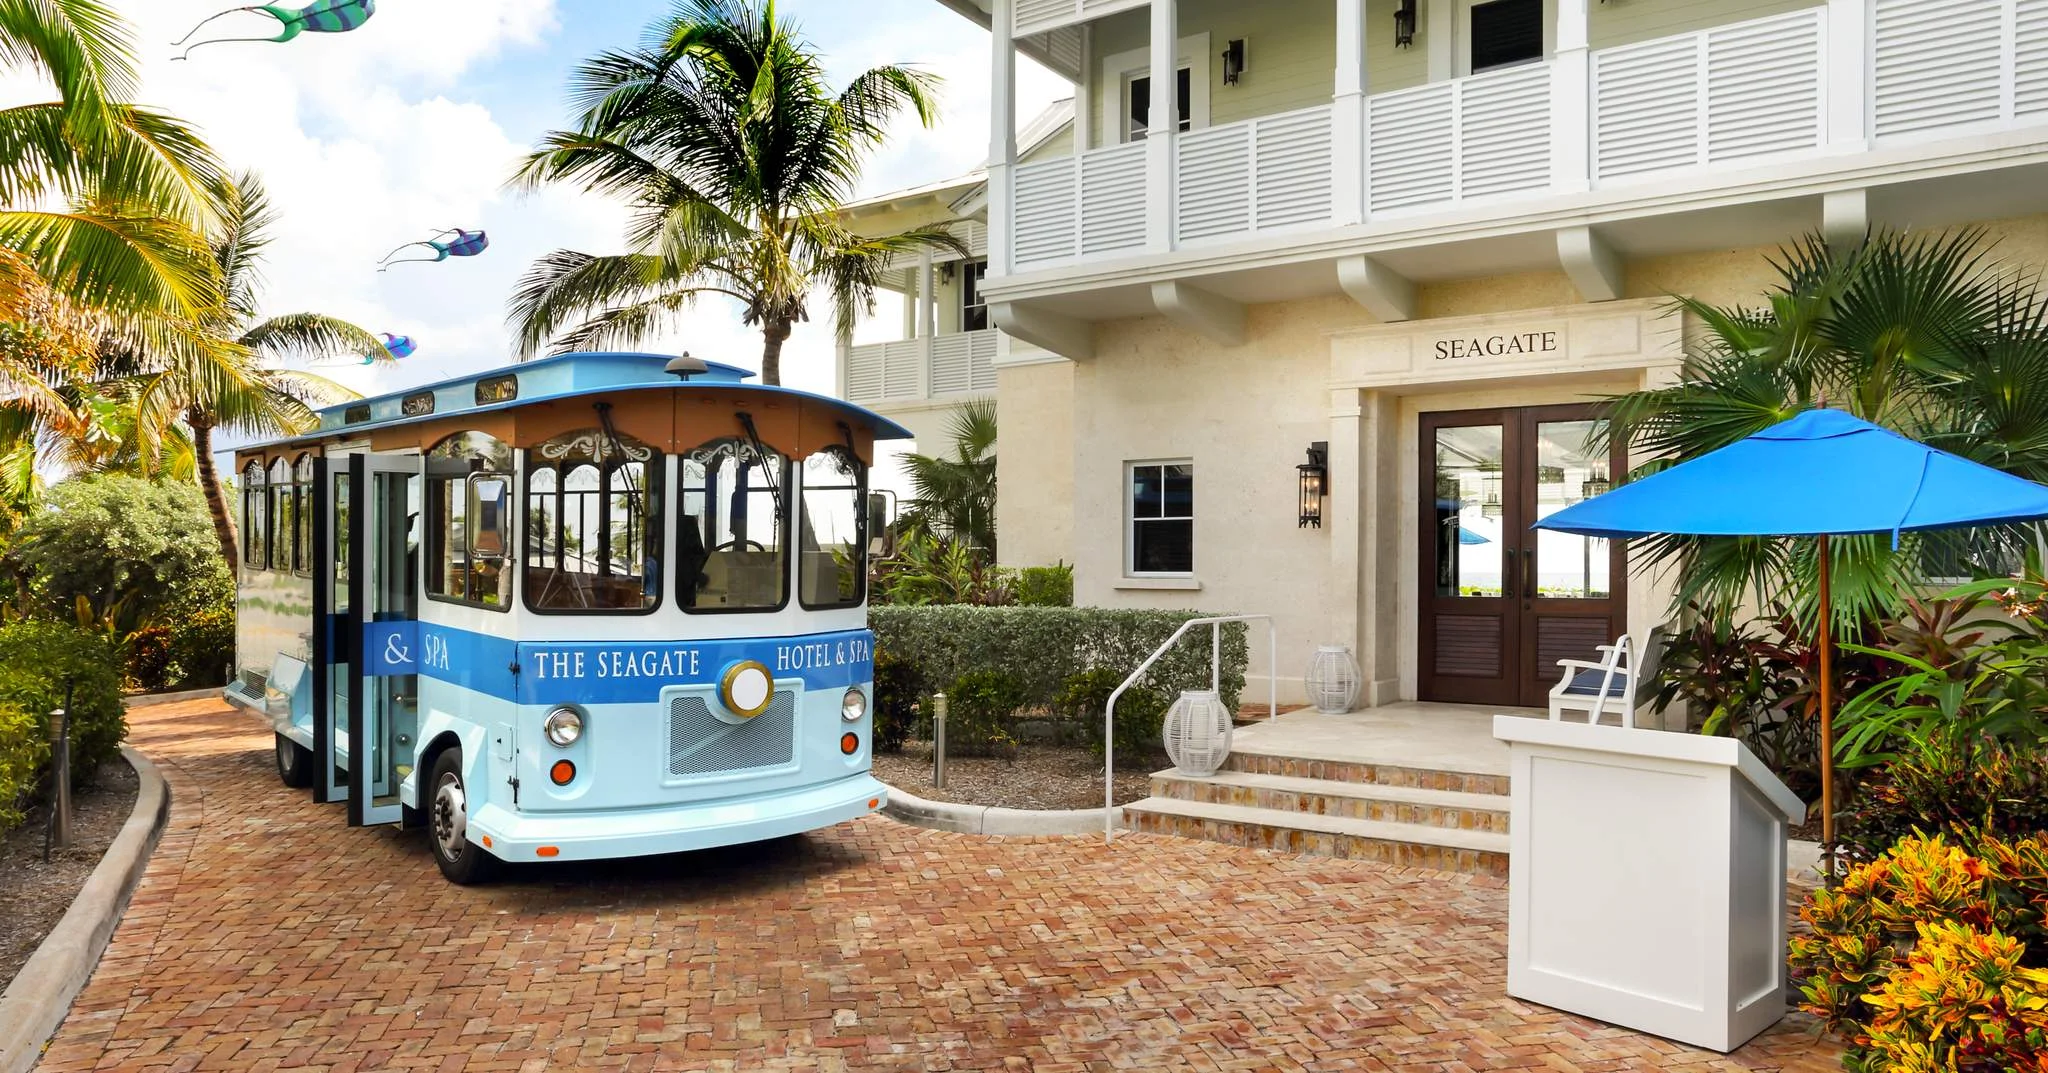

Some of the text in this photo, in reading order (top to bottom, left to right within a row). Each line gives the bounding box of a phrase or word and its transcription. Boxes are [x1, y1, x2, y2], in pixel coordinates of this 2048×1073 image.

[1435, 331, 1557, 360] SEAGATE
[384, 633, 450, 671] & SPA
[534, 639, 870, 679] THE SEAGATE HOTEL & SPA
